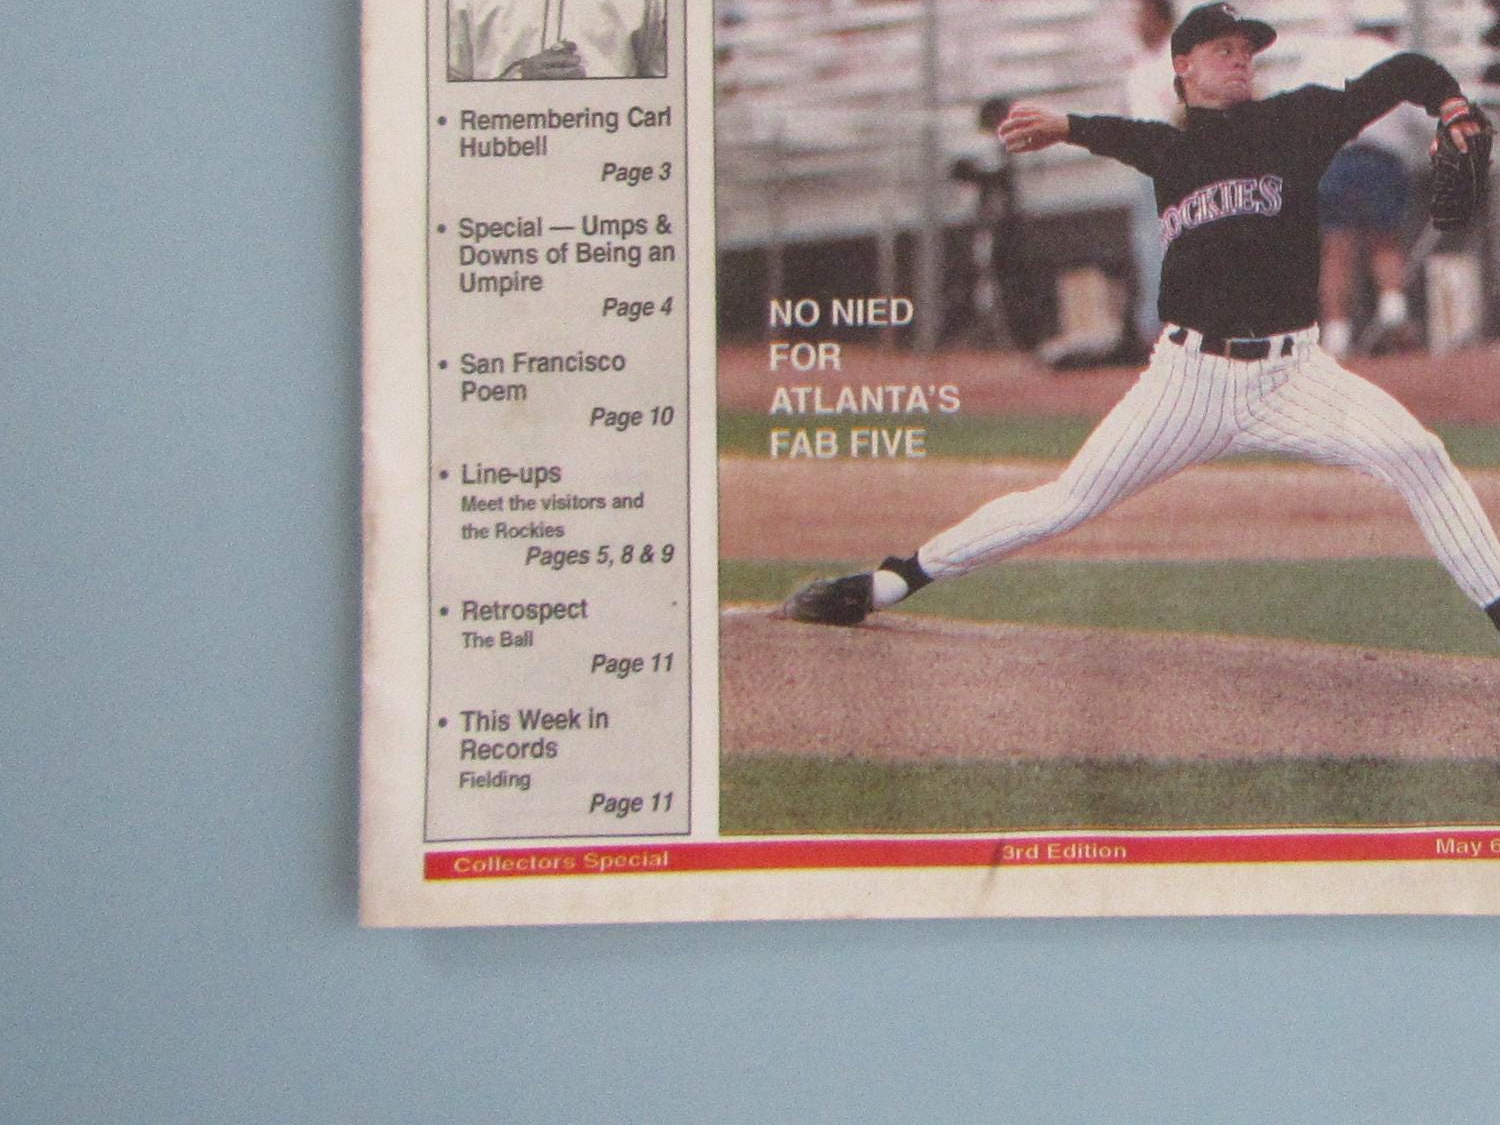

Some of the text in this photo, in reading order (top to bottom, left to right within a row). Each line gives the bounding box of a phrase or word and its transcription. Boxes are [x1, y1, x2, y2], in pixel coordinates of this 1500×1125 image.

[460, 106, 671, 133] Remembering Carl
[459, 136, 547, 157] Hubbell
[601, 163, 671, 186] Page 3
[459, 217, 542, 243] Special
[582, 215, 648, 239] Umps
[656, 215, 672, 234] &
[459, 242, 675, 266] Downs of Being an
[459, 271, 543, 296] Umpire
[602, 297, 673, 321] Page 4
[769, 298, 913, 327] NO NIED
[460, 350, 626, 373] San Francisco
[769, 344, 841, 371] FOR
[461, 381, 527, 401] Poem
[769, 385, 960, 414] ATLANTA'S
[590, 406, 674, 431] Page 10
[770, 429, 926, 459] FAB FIVE
[462, 463, 561, 487] Line-ups
[462, 493, 644, 512] Meet the visitors and
[462, 523, 564, 539] the Rockies
[526, 544, 674, 570] Pages 5, 8 & 9
[462, 599, 588, 624] Retrospect
[462, 631, 533, 648] The Ball
[591, 653, 674, 678] Page 11
[460, 709, 608, 732] This Week in
[460, 738, 557, 760] Records
[460, 772, 530, 790] Fielding
[590, 792, 673, 817] Page 11
[1002, 841, 1127, 860] 3rd Edition
[1435, 838, 1483, 858] May
[454, 851, 669, 873] Collectors Special
